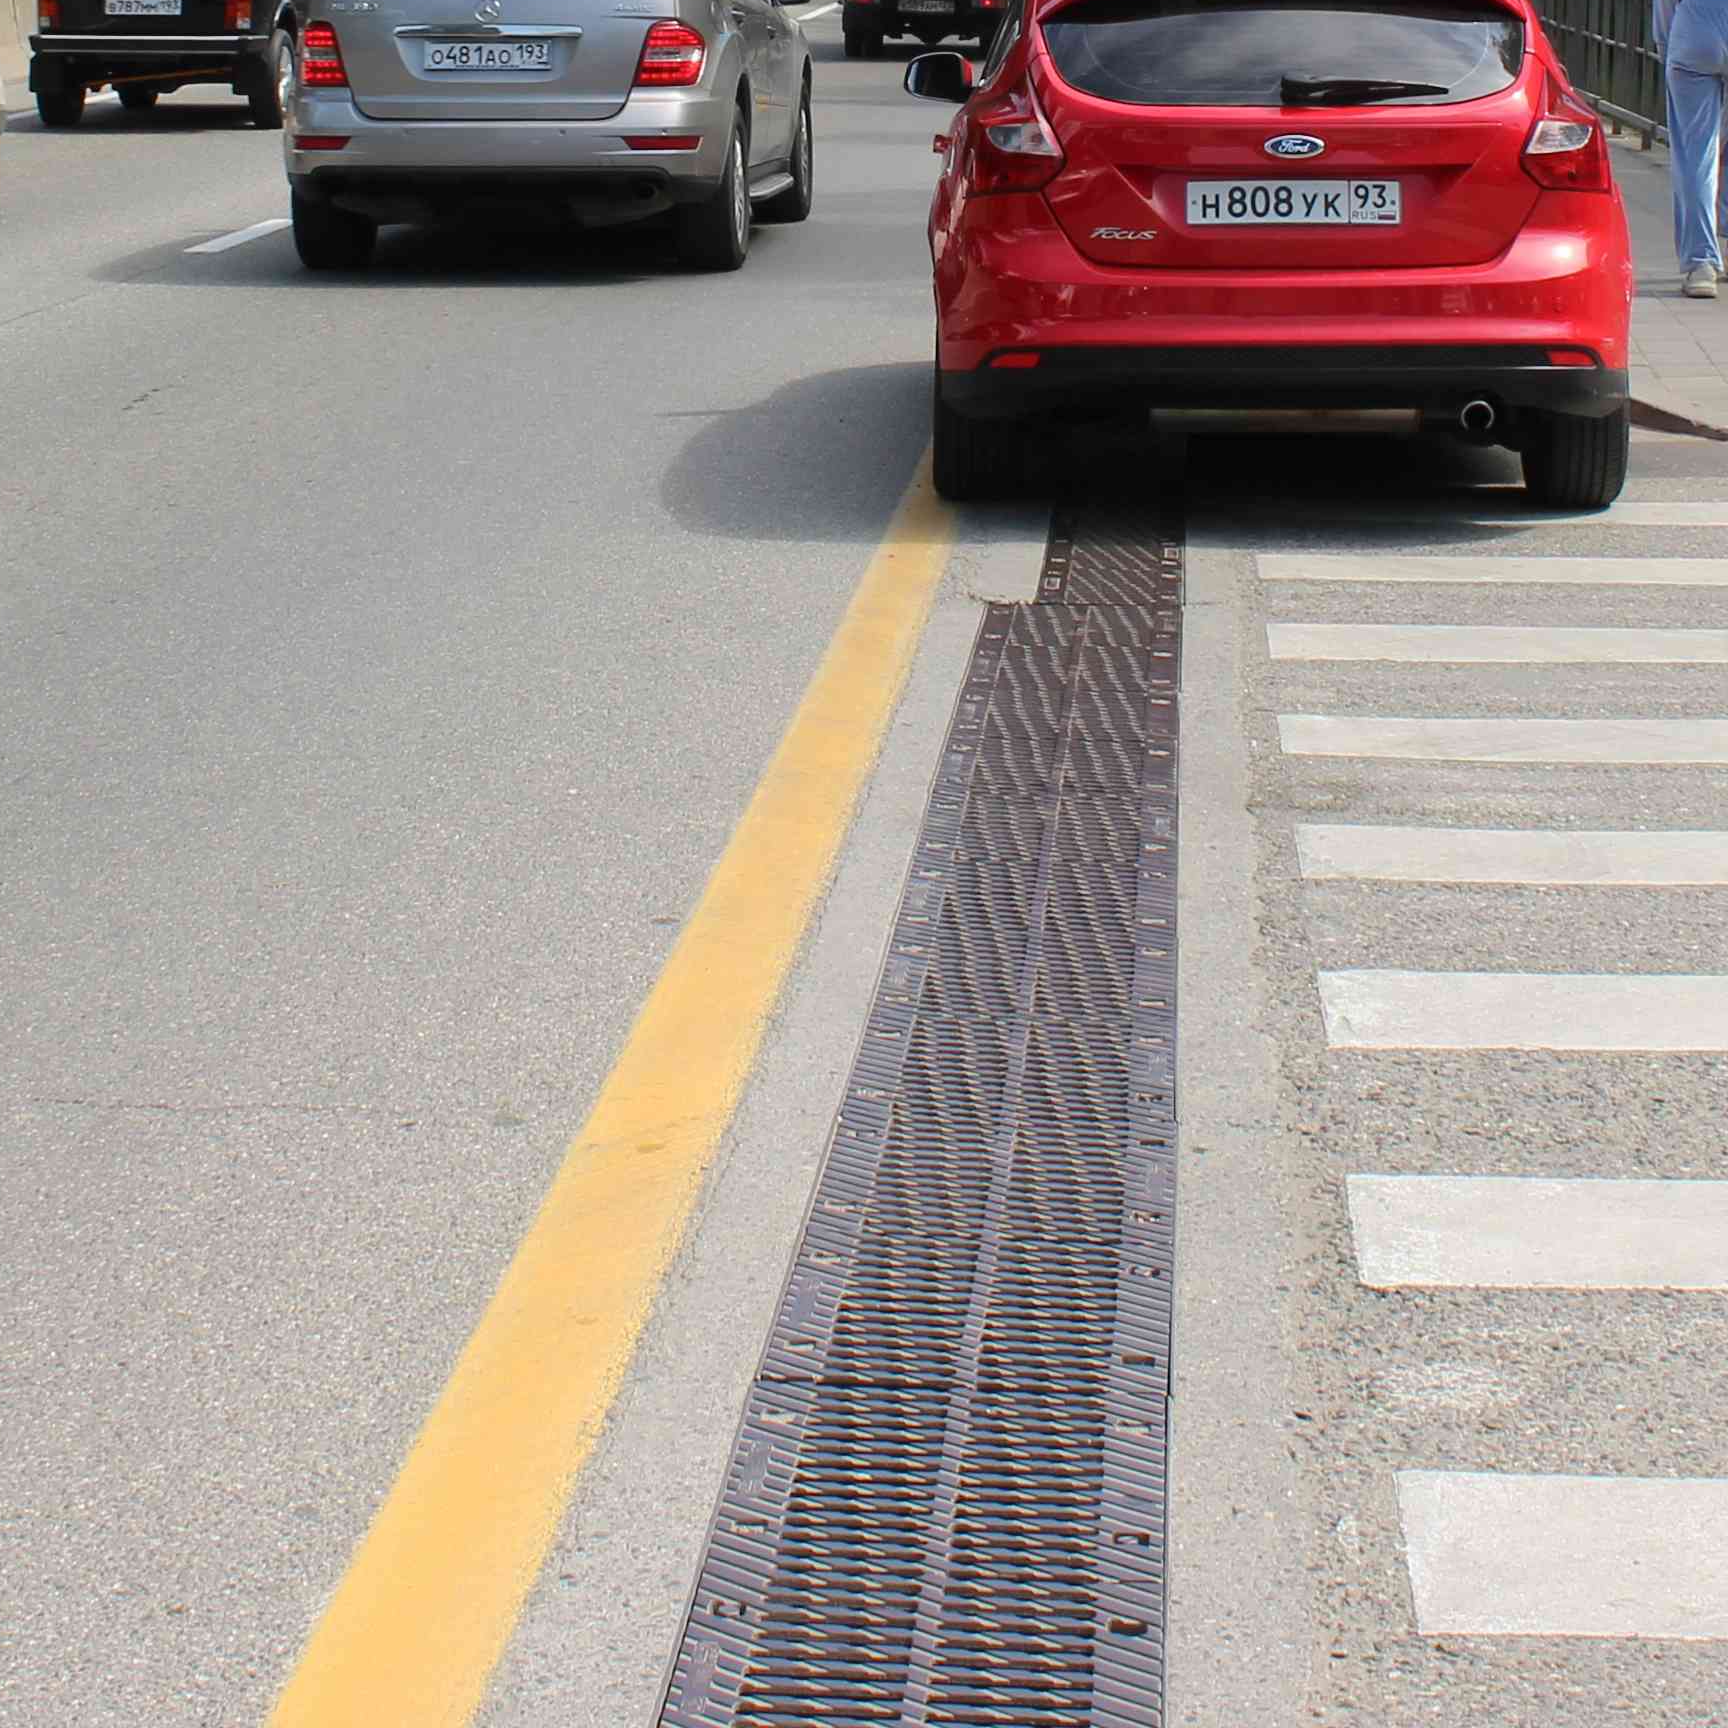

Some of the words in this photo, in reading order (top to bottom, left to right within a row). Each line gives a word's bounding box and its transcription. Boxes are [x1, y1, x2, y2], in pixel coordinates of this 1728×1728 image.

[1278, 139, 1312, 153] Ford
[1354, 184, 1388, 209] 93
[1351, 210, 1377, 221] RUS
